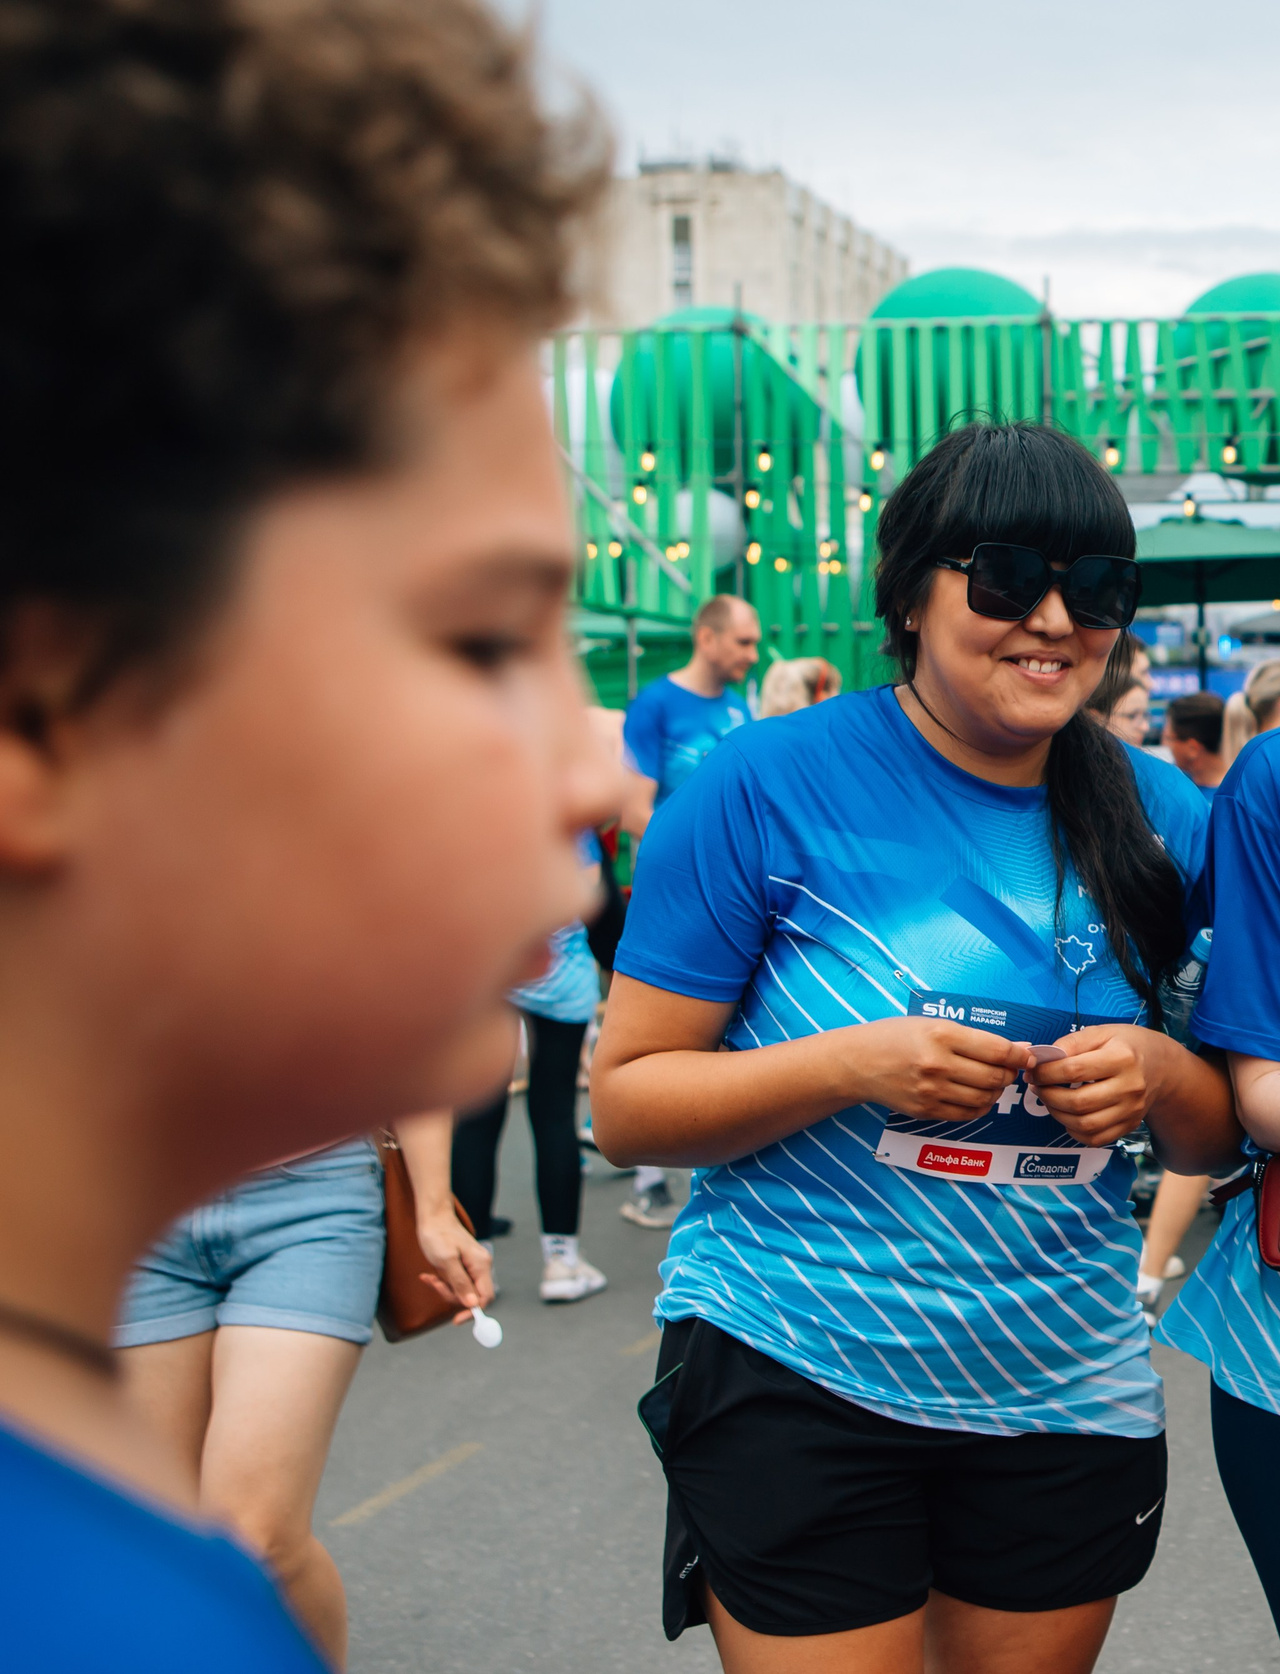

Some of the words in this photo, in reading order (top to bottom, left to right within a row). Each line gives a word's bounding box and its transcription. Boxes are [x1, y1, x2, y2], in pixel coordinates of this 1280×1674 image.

[970, 1015, 1006, 1027] МАРАФОН
[924, 1151, 958, 1165] Альфа
[960, 1155, 986, 1168] Банк
[1026, 1162, 1075, 1174] Следопыт
